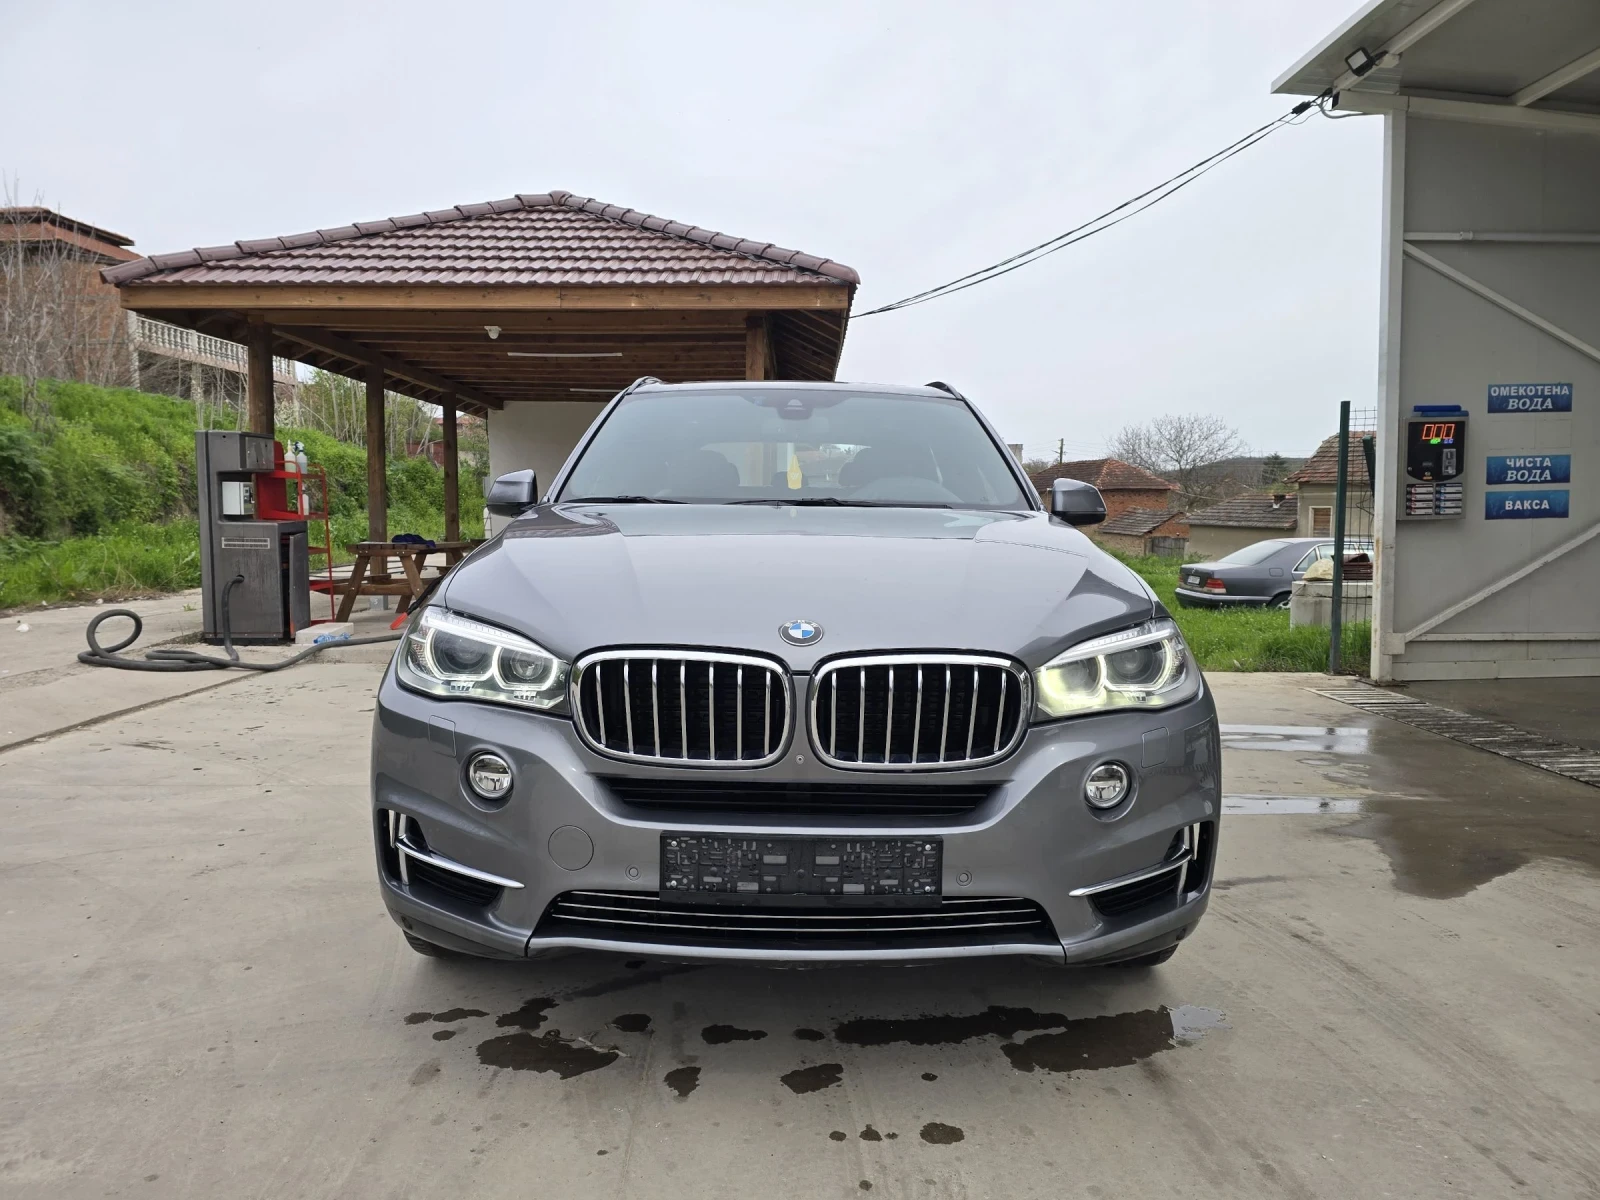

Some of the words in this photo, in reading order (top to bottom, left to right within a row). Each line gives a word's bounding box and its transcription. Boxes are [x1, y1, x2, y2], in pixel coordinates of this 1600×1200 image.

[1490, 385, 1570, 397] ОМЕКОТЕНА
[1507, 397, 1553, 411] ВОДА
[1506, 457, 1552, 468] ЧИСТА
[1505, 469, 1552, 482] ВОДА
[1505, 499, 1550, 510] ВАКСА
